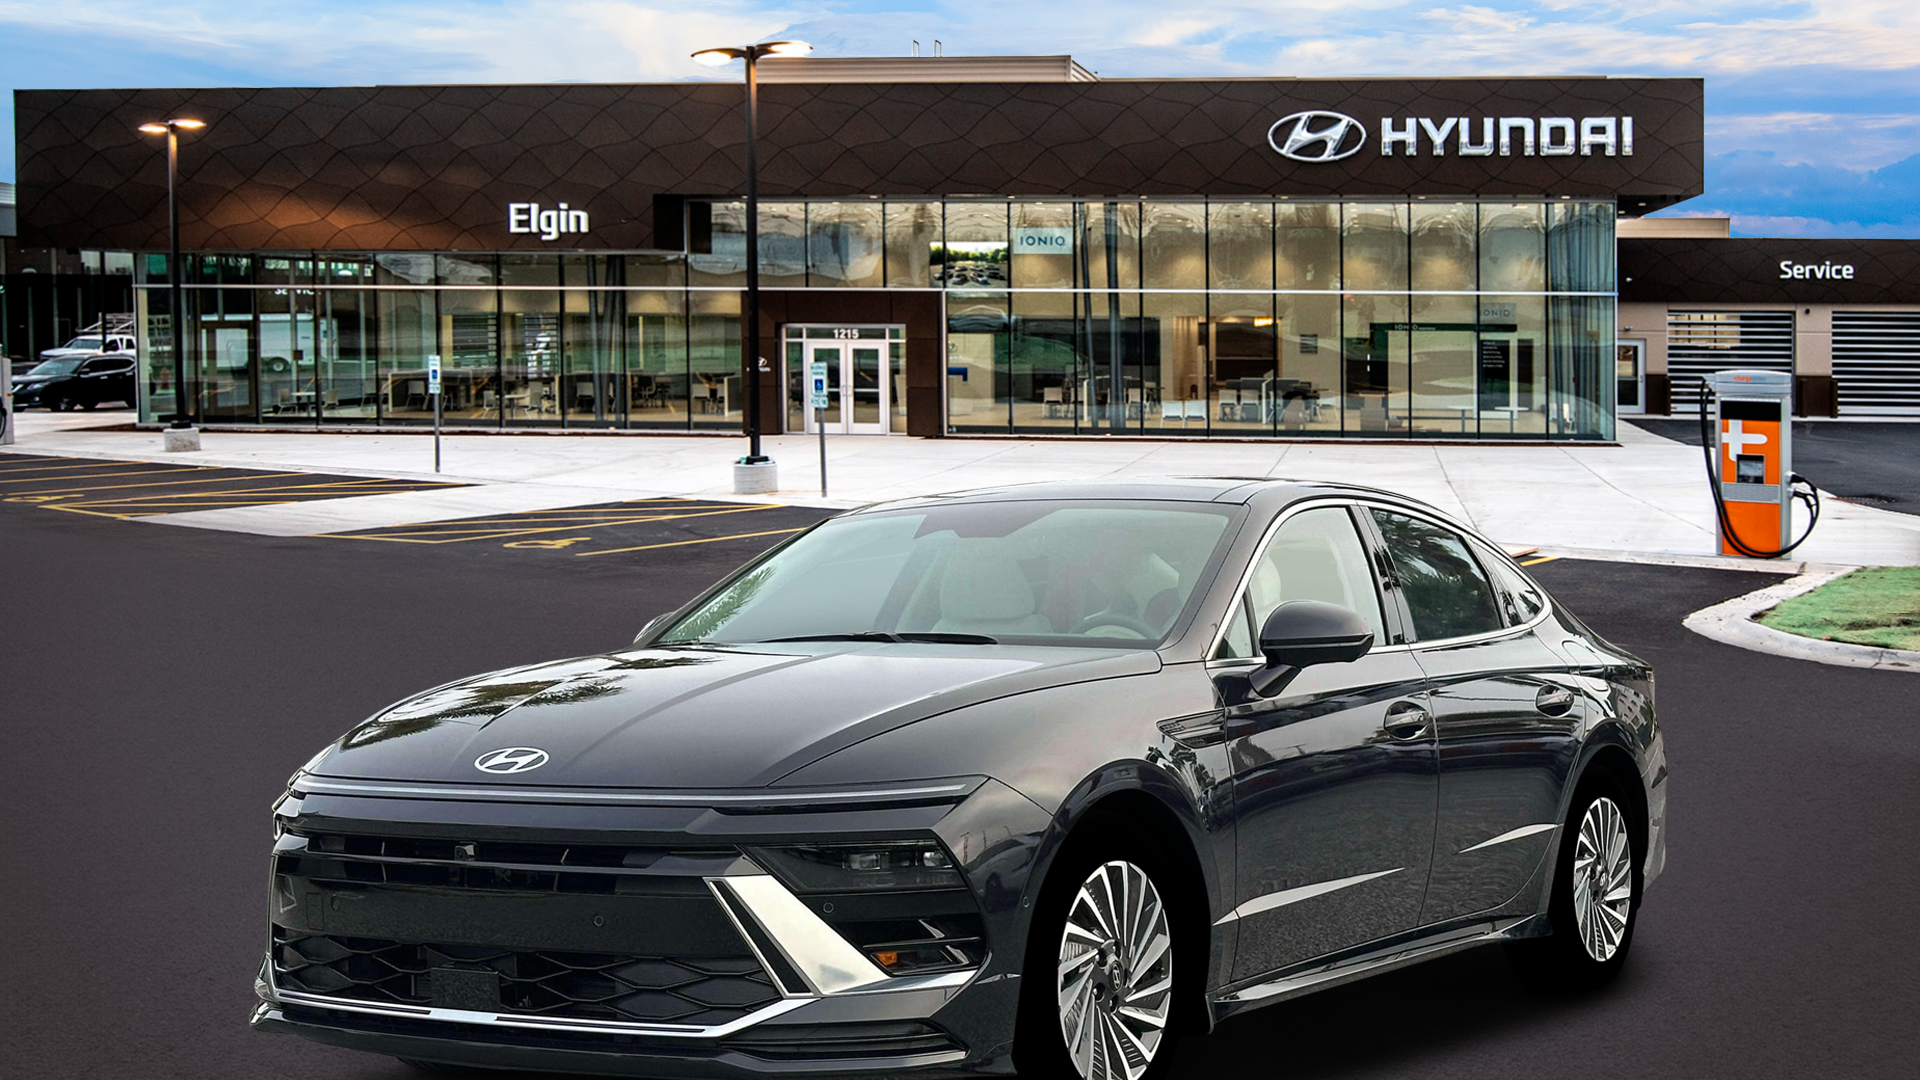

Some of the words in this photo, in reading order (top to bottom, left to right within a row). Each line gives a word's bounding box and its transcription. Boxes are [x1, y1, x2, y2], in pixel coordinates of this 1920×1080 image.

[1381, 116, 1634, 156] HYUNDAI
[508, 203, 590, 240] Elgin
[1020, 236, 1066, 246] IONIQ
[1780, 260, 1854, 279] Service
[833, 328, 859, 339] 1215
